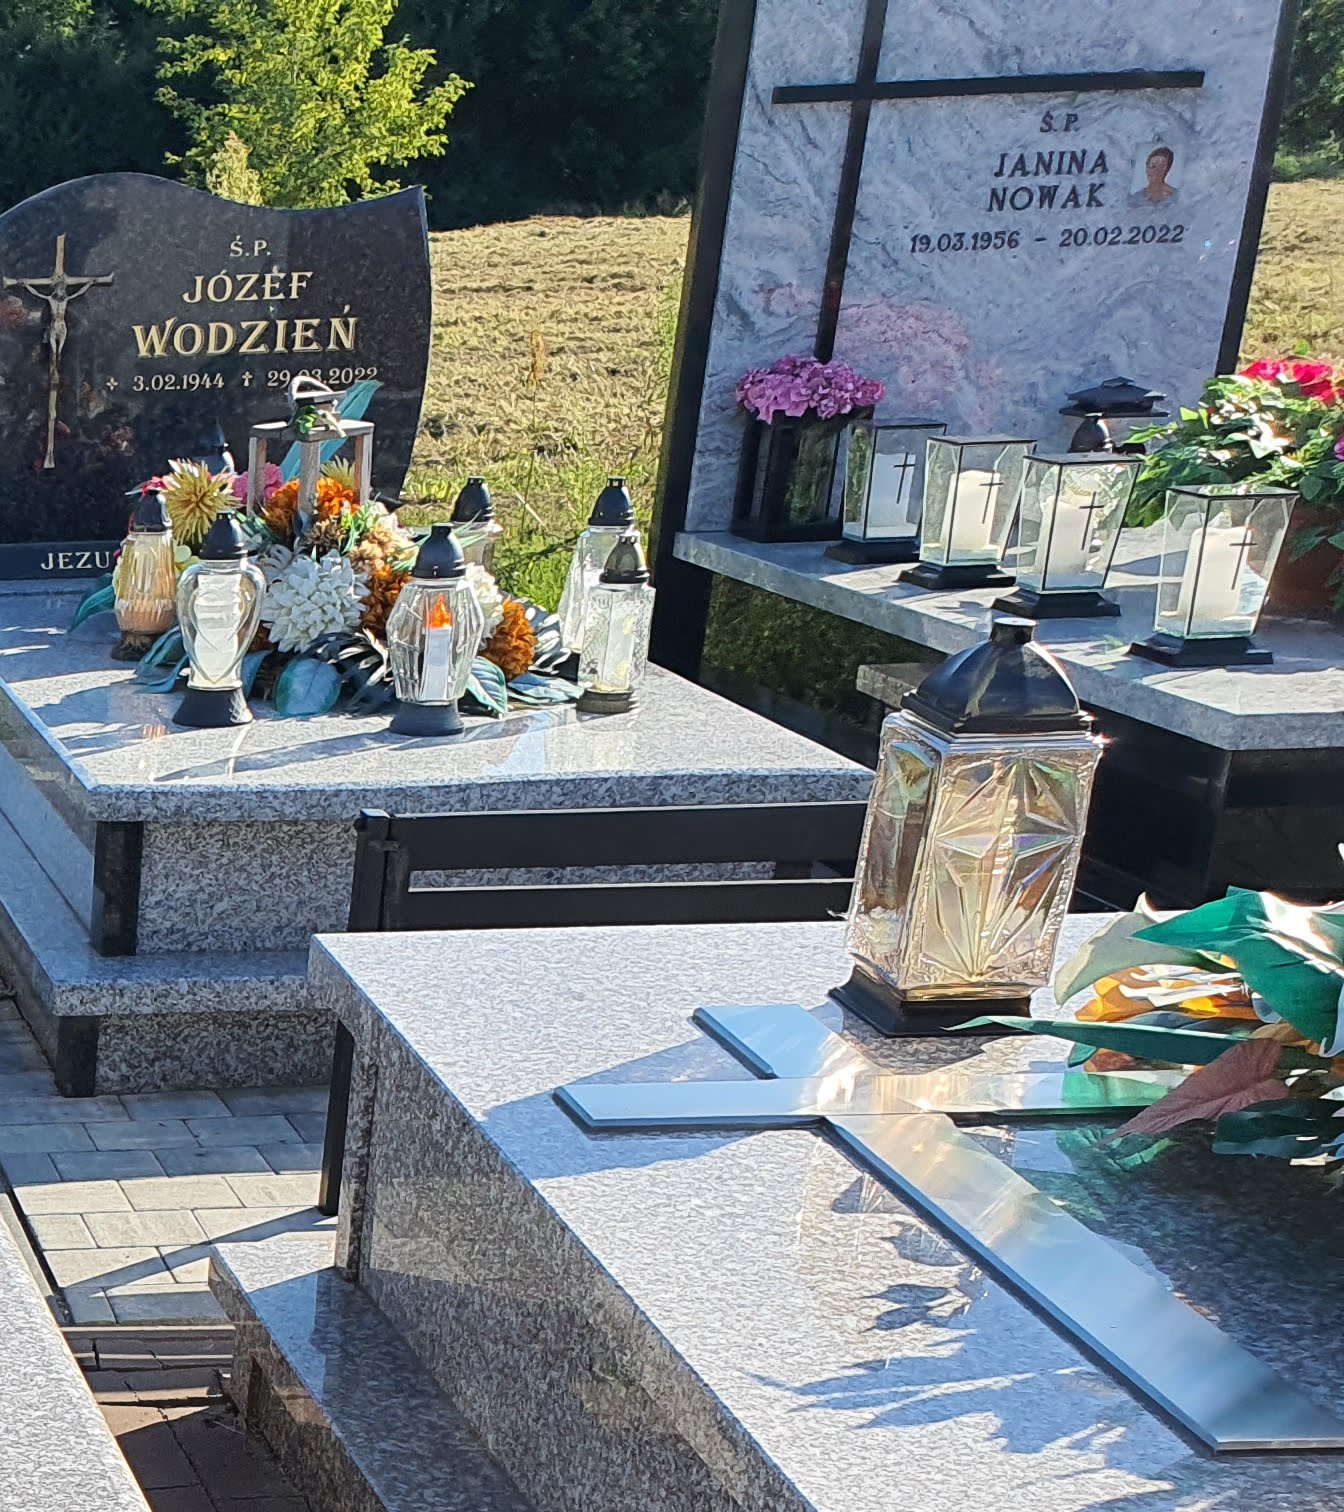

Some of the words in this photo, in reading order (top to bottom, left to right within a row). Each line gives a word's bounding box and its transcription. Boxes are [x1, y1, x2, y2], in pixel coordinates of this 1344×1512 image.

[993, 150, 1108, 177] JANINA
[987, 183, 1105, 212] NOWAK
[1059, 224, 1185, 247] 20.02.2022
[182, 269, 313, 304] JÓZEF
[132, 305, 359, 358] WODZIEŃ
[132, 373, 225, 392] 3.02.1944
[40, 551, 110, 570] JEZU
